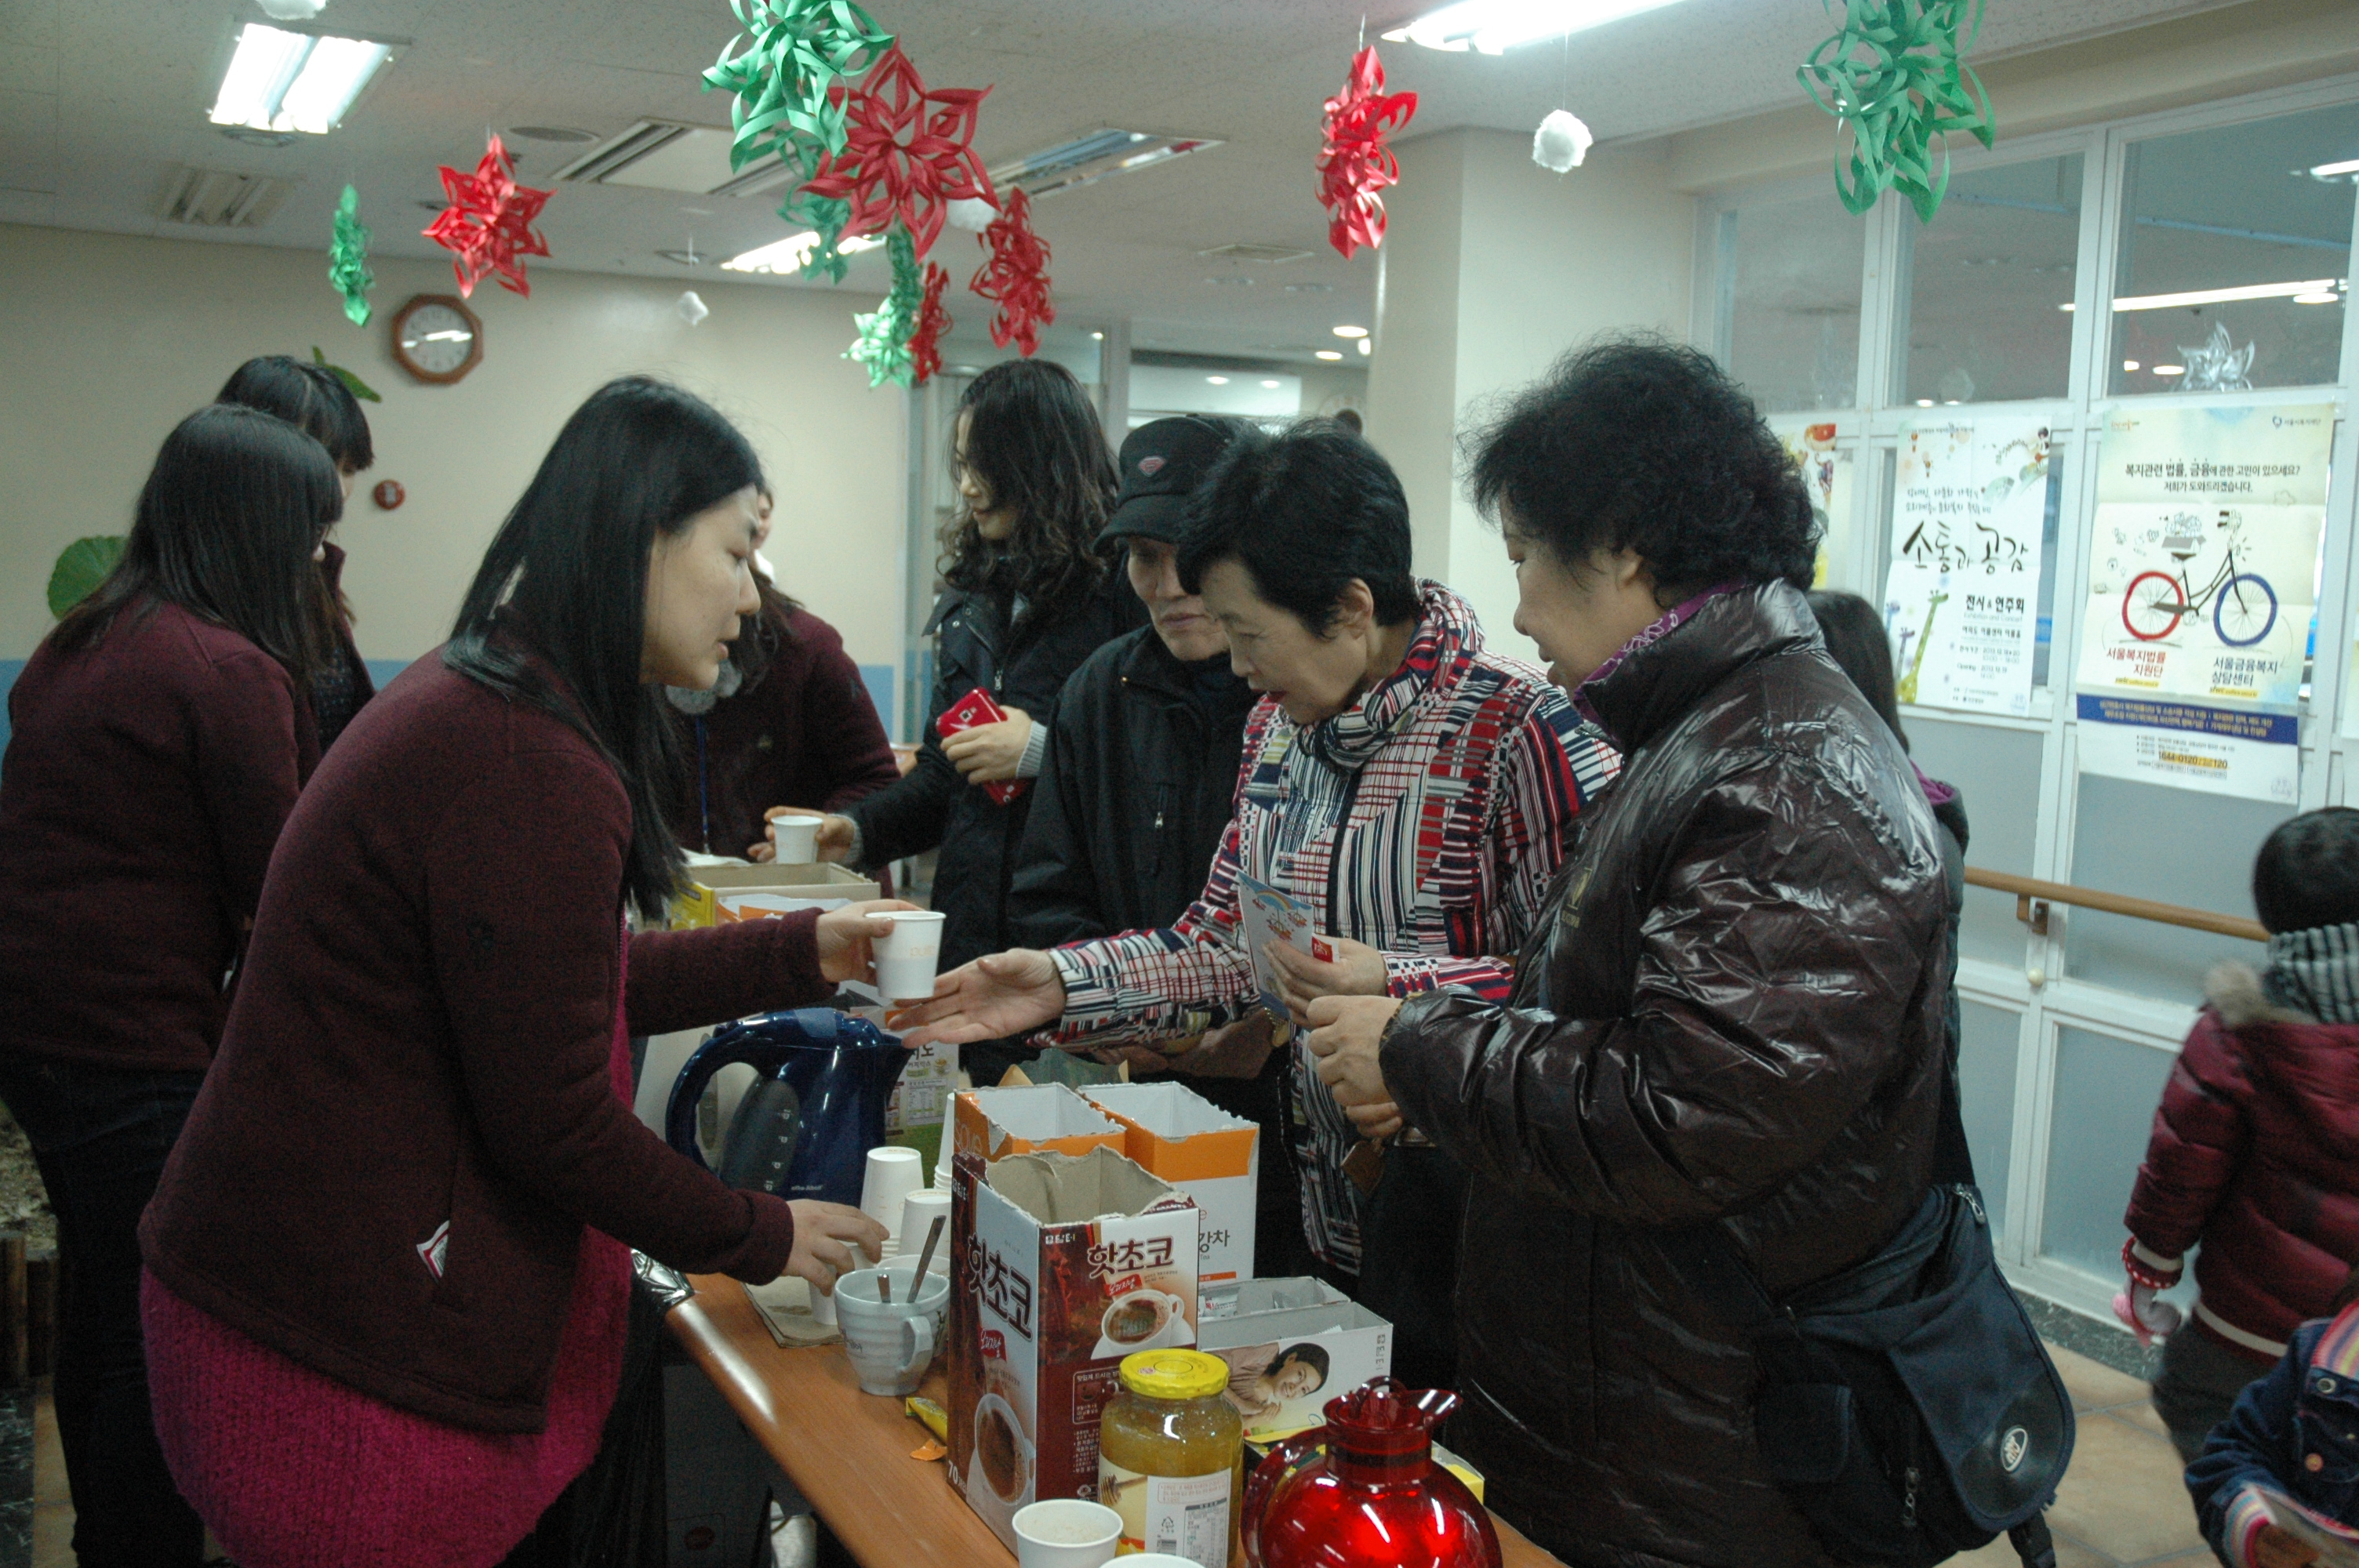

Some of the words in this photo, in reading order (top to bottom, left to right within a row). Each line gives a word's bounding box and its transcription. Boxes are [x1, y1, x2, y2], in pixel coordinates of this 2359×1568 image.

[2125, 463, 2163, 477] 복지관련
[2165, 461, 2187, 478] 법률,
[2190, 461, 2217, 478] 금융에
[2219, 465, 2234, 477] 관한
[2236, 465, 2260, 477] 고민이
[2262, 465, 2300, 477] 있으세요?
[2164, 481, 2187, 492] 저희가
[2189, 481, 2253, 493] 도와드리겠습니다.
[1902, 520, 1970, 574] 소통과
[1975, 521, 2029, 575] 공감
[1966, 594, 1985, 612] 전시
[1995, 596, 2025, 614] 연주회
[2106, 647, 2166, 665] 서울복지법률
[2214, 655, 2278, 674] 서울금융복지
[2133, 663, 2163, 678] 지원단
[2212, 671, 2254, 688] 상담센터
[1087, 1235, 1175, 1279] 핫초코
[969, 1232, 1033, 1342] 핫초코
[1109, 1276, 1136, 1294] 오리지널
[948, 1459, 958, 1485] 70
